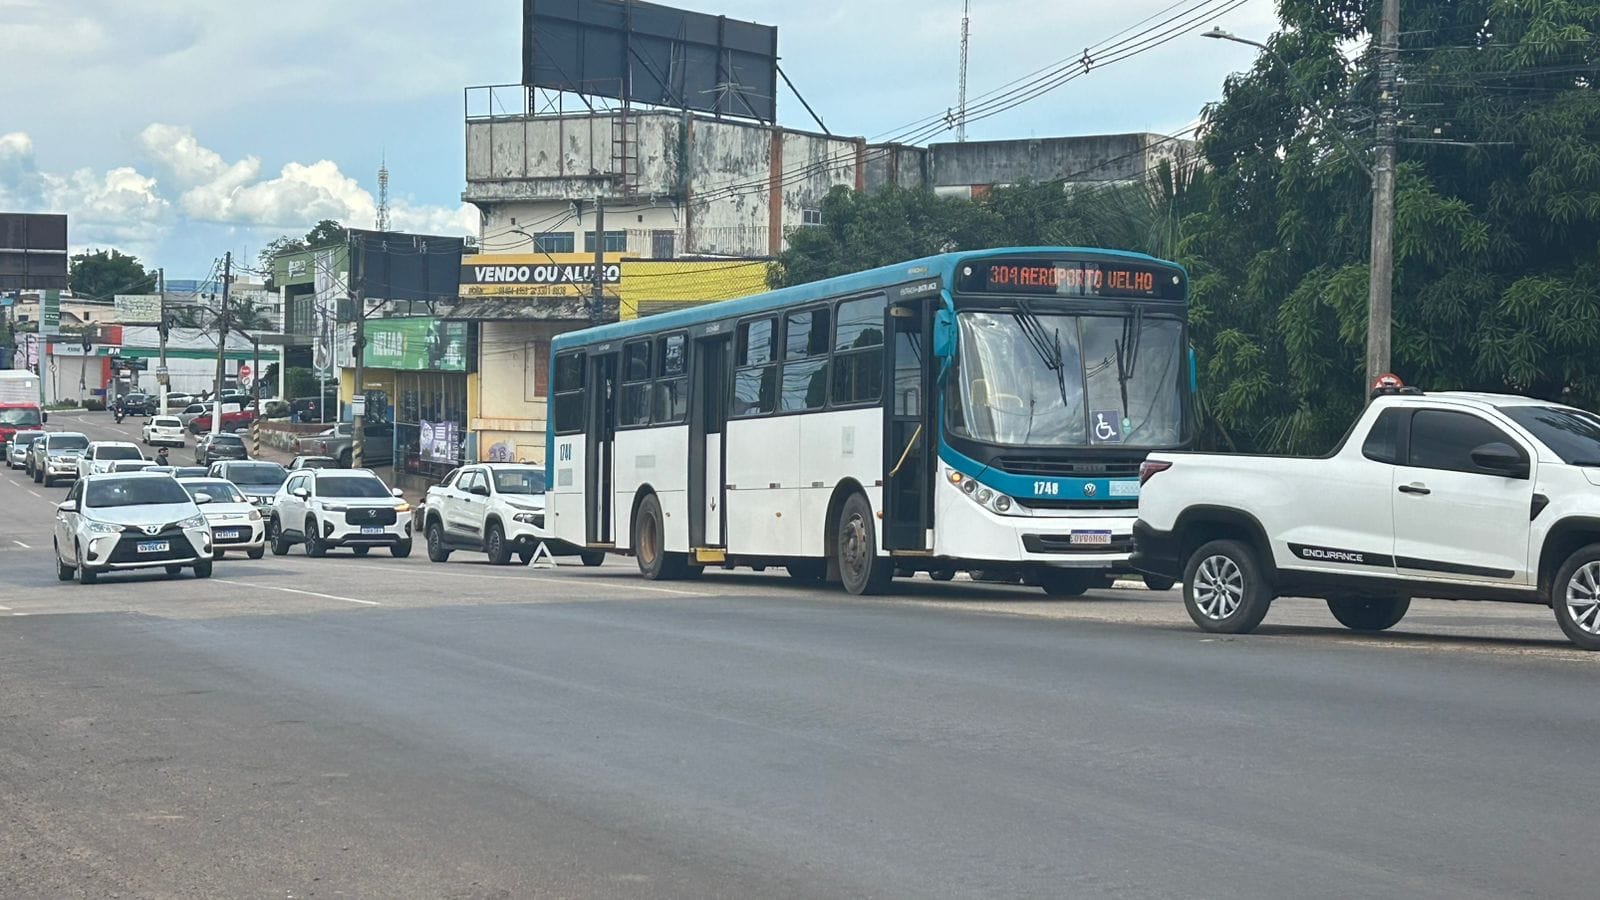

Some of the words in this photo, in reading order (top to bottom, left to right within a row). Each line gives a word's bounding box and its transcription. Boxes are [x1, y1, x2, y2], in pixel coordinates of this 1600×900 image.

[474, 266, 530, 282] VENDO
[534, 266, 558, 282] OU
[1020, 266, 1103, 289] AEROPORTO
[1108, 271, 1153, 290] VELHO
[1302, 548, 1364, 562] ENDURANCE
